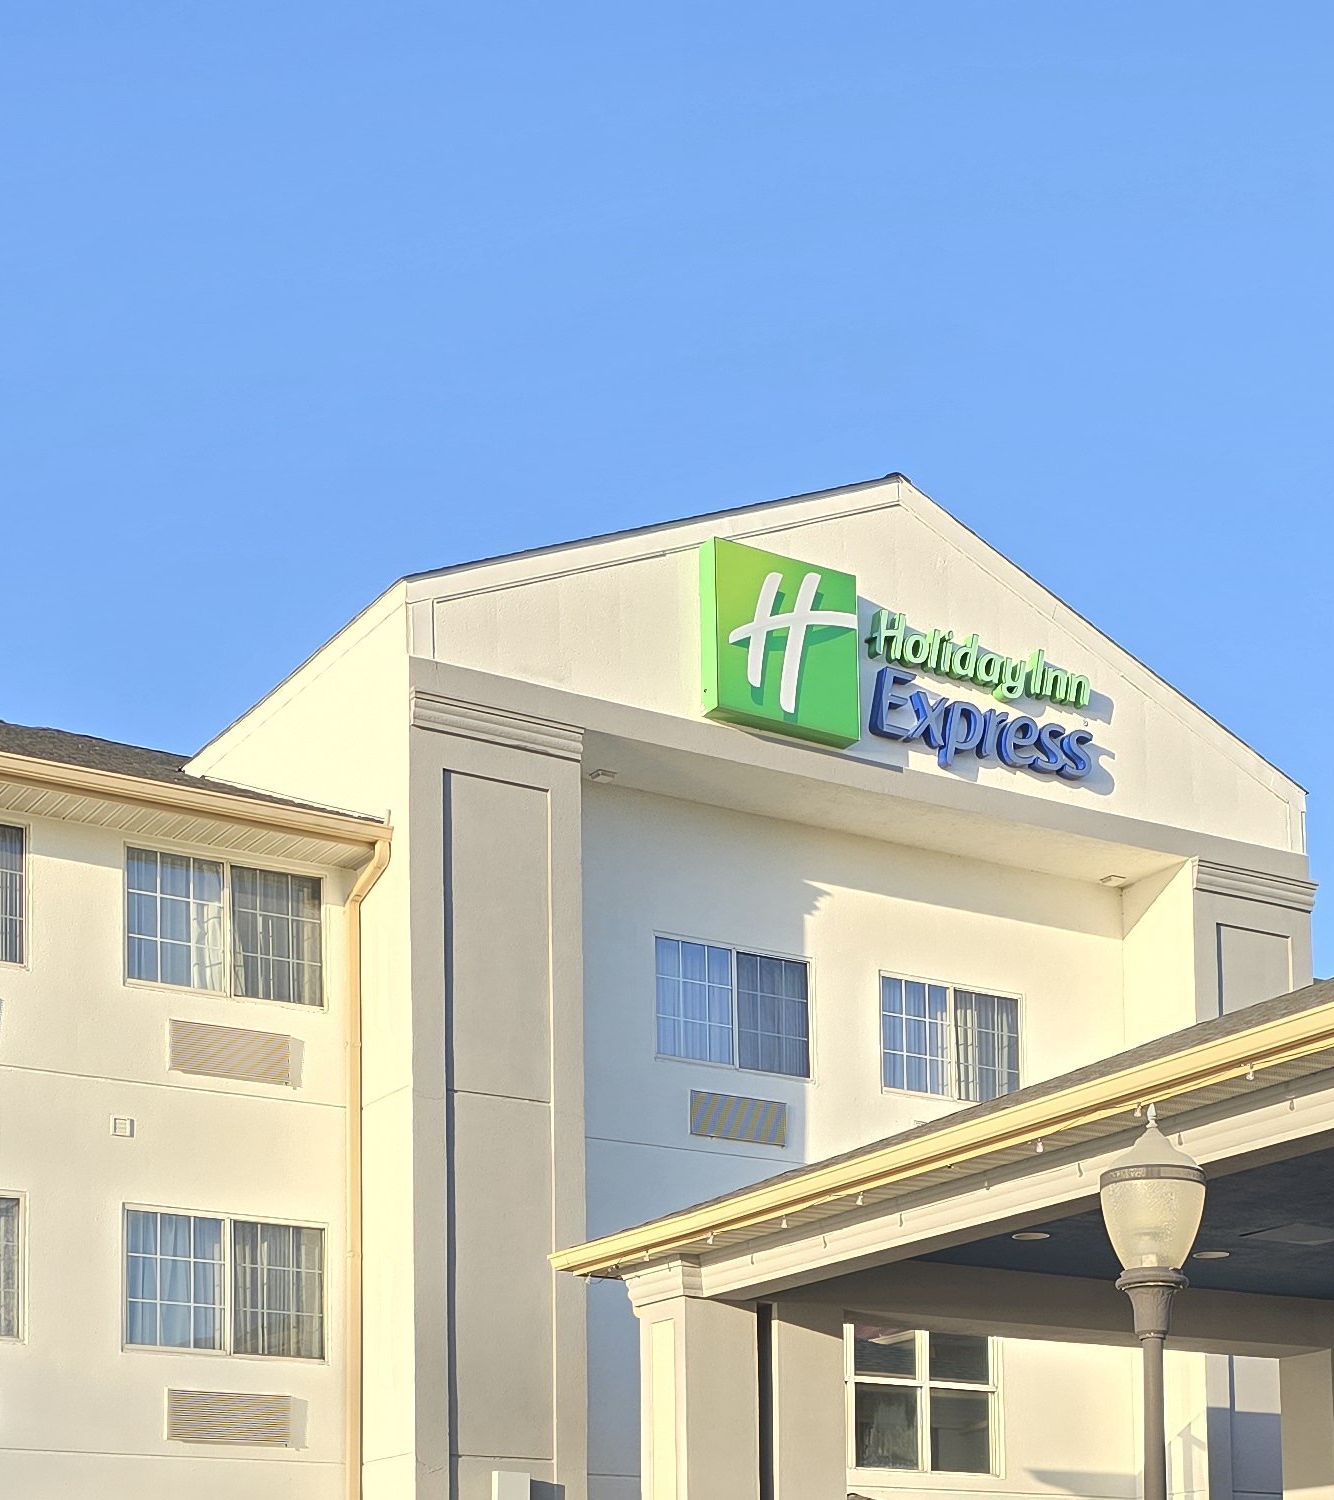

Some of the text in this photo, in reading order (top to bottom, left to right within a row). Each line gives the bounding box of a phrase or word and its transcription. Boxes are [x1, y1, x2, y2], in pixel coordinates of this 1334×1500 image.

[869, 608, 1092, 709] Holiday Inn
[869, 666, 1094, 781] Express
